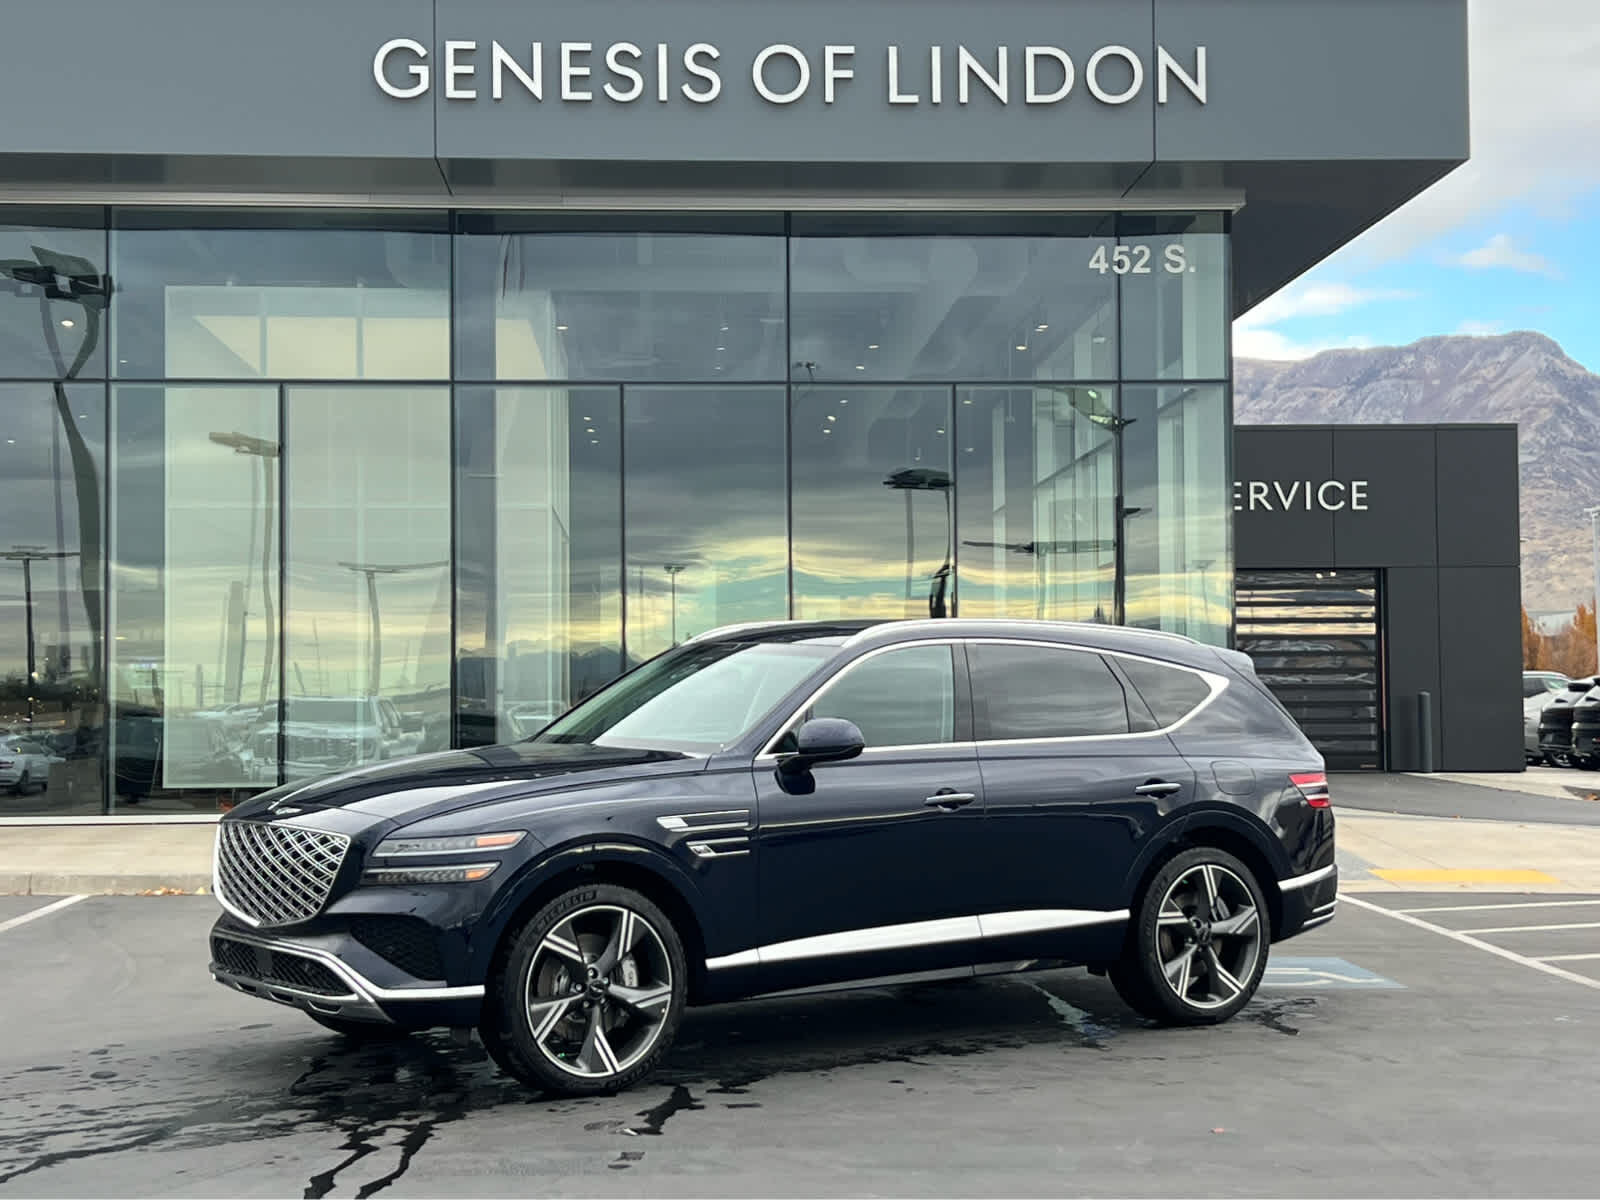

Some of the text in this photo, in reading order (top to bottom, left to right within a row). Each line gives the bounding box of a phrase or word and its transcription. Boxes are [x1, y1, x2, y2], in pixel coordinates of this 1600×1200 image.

[373, 38, 1207, 105] GENESIS OF LINDON
[1088, 243, 1196, 275] 452 S.
